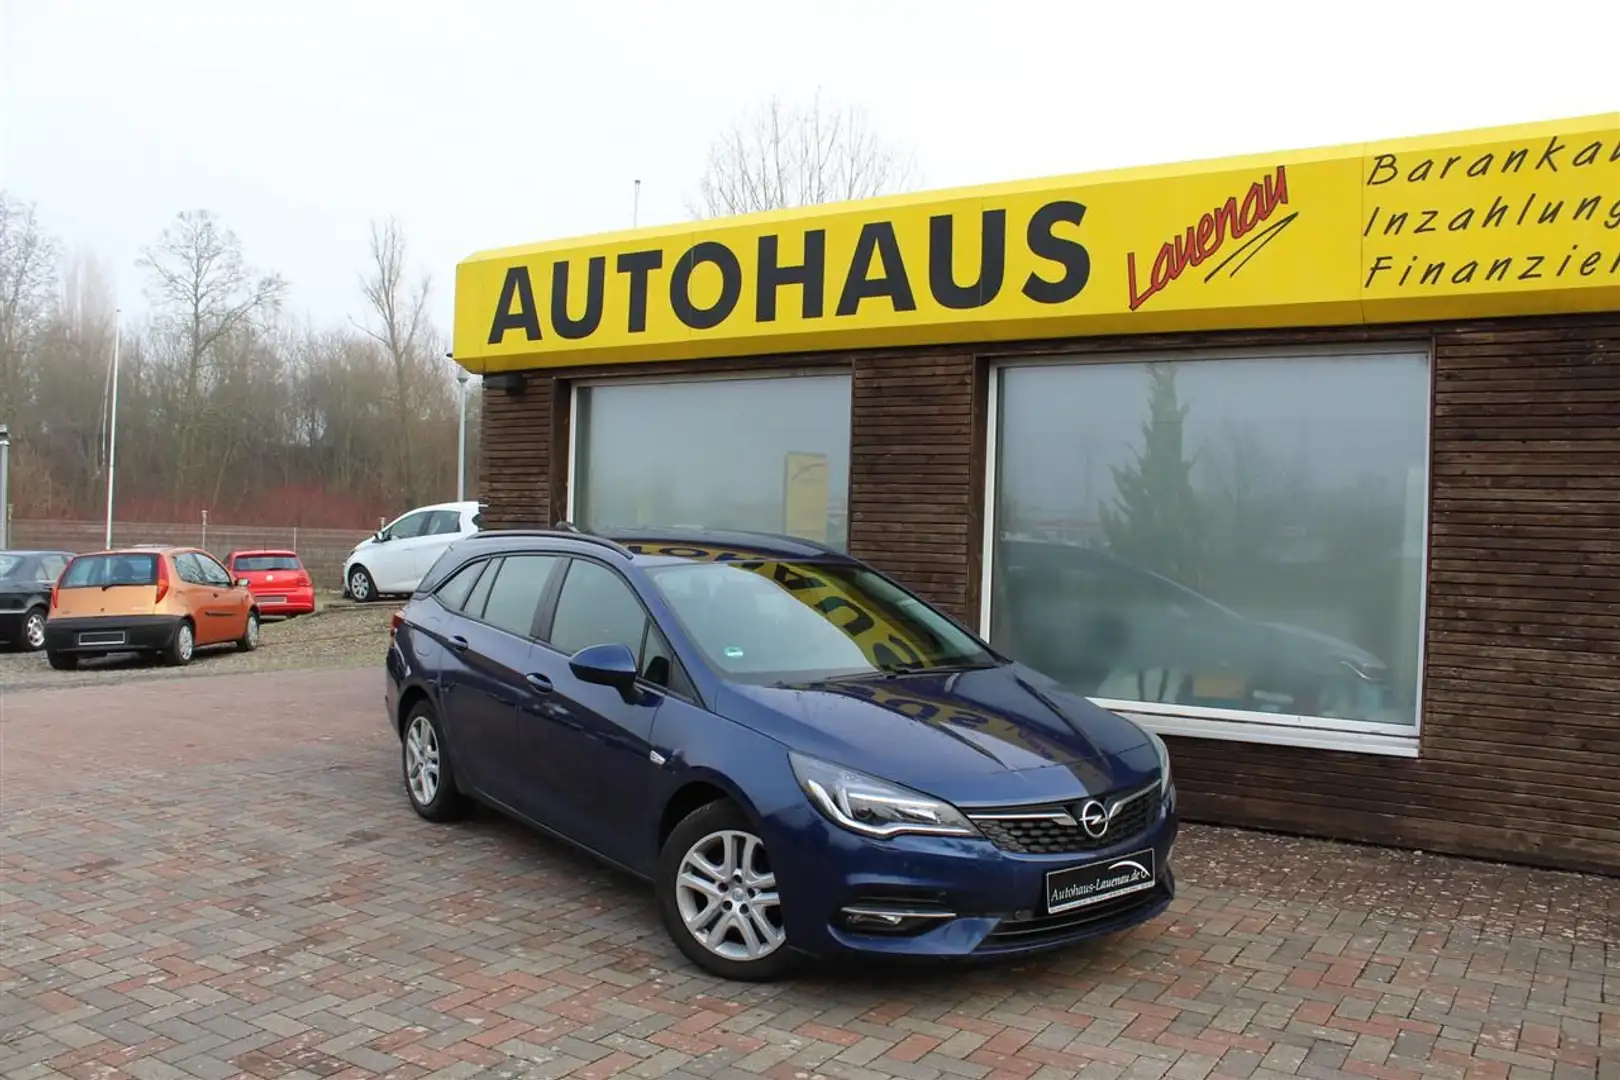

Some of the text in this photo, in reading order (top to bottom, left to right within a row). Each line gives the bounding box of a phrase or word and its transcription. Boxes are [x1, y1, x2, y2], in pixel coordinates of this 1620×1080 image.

[488, 165, 1289, 345] AUTOHAUS Lauenau
[1050, 868, 1140, 902] Autohaus-Lauenau.de
